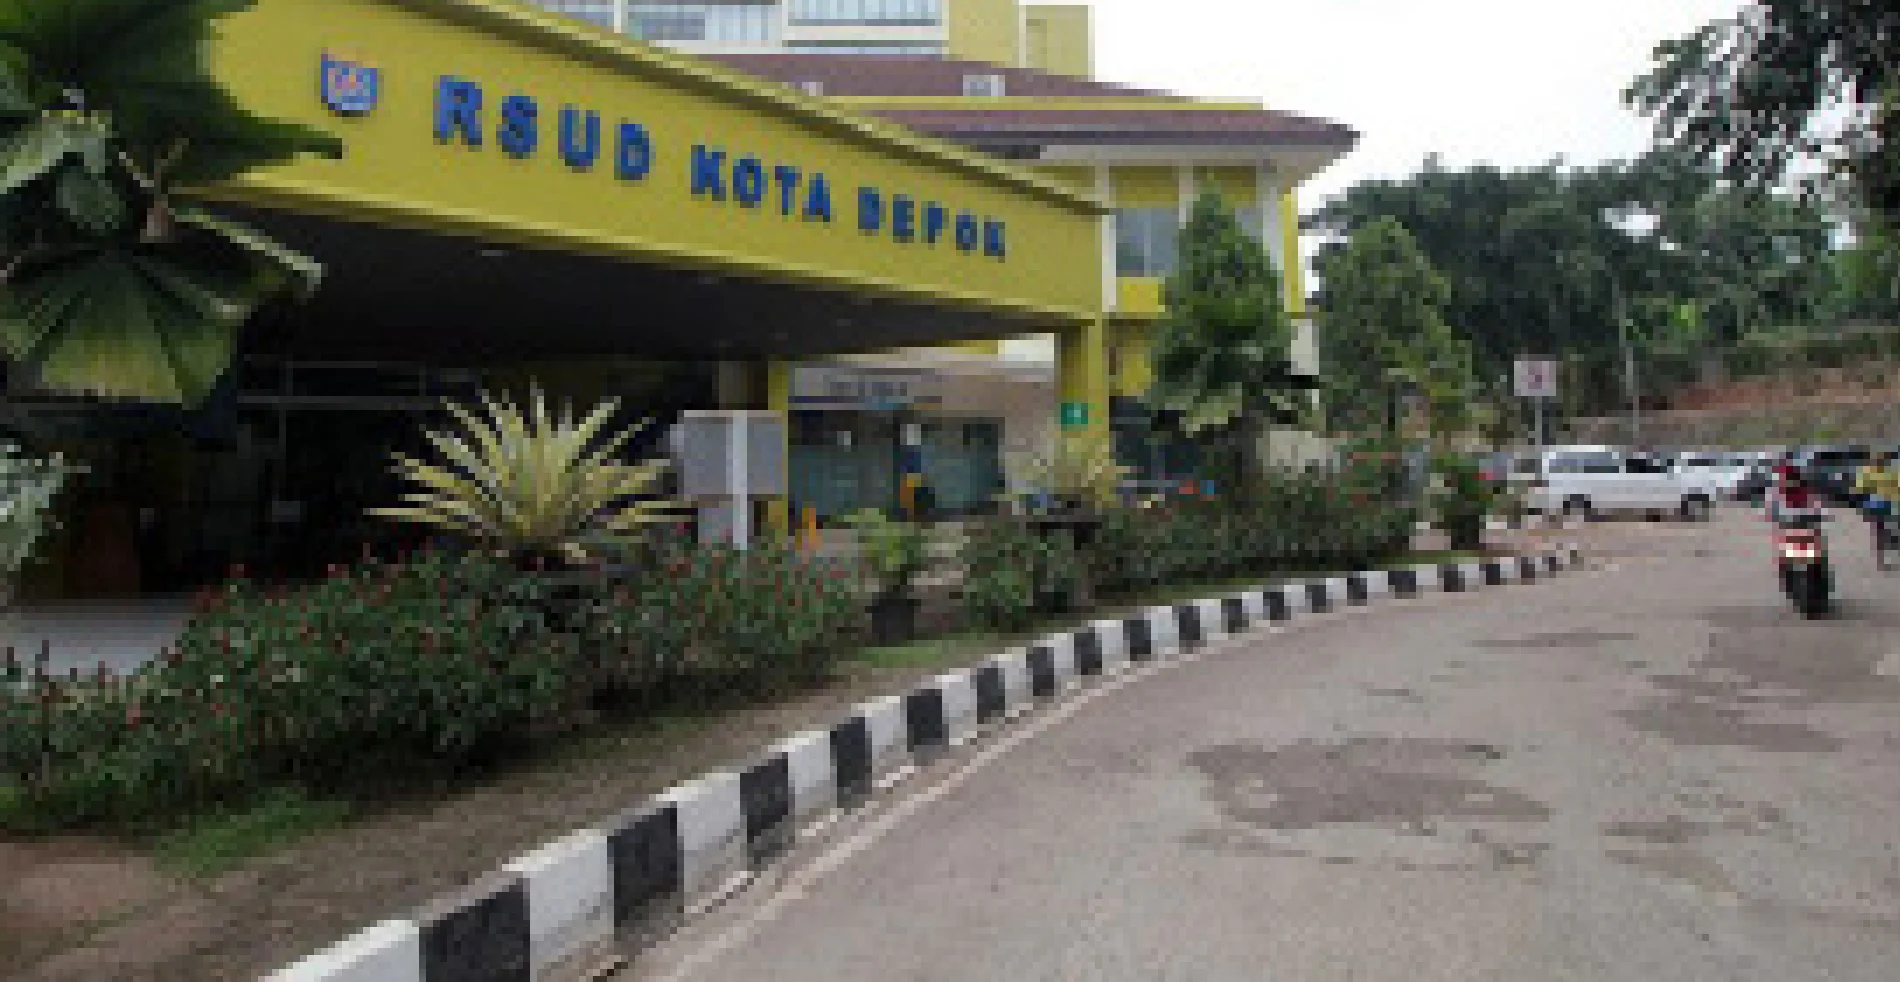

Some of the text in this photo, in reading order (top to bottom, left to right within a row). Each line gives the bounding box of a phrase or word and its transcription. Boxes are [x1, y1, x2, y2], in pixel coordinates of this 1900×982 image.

[432, 75, 1006, 262] RSUD KOTA DEPOK
